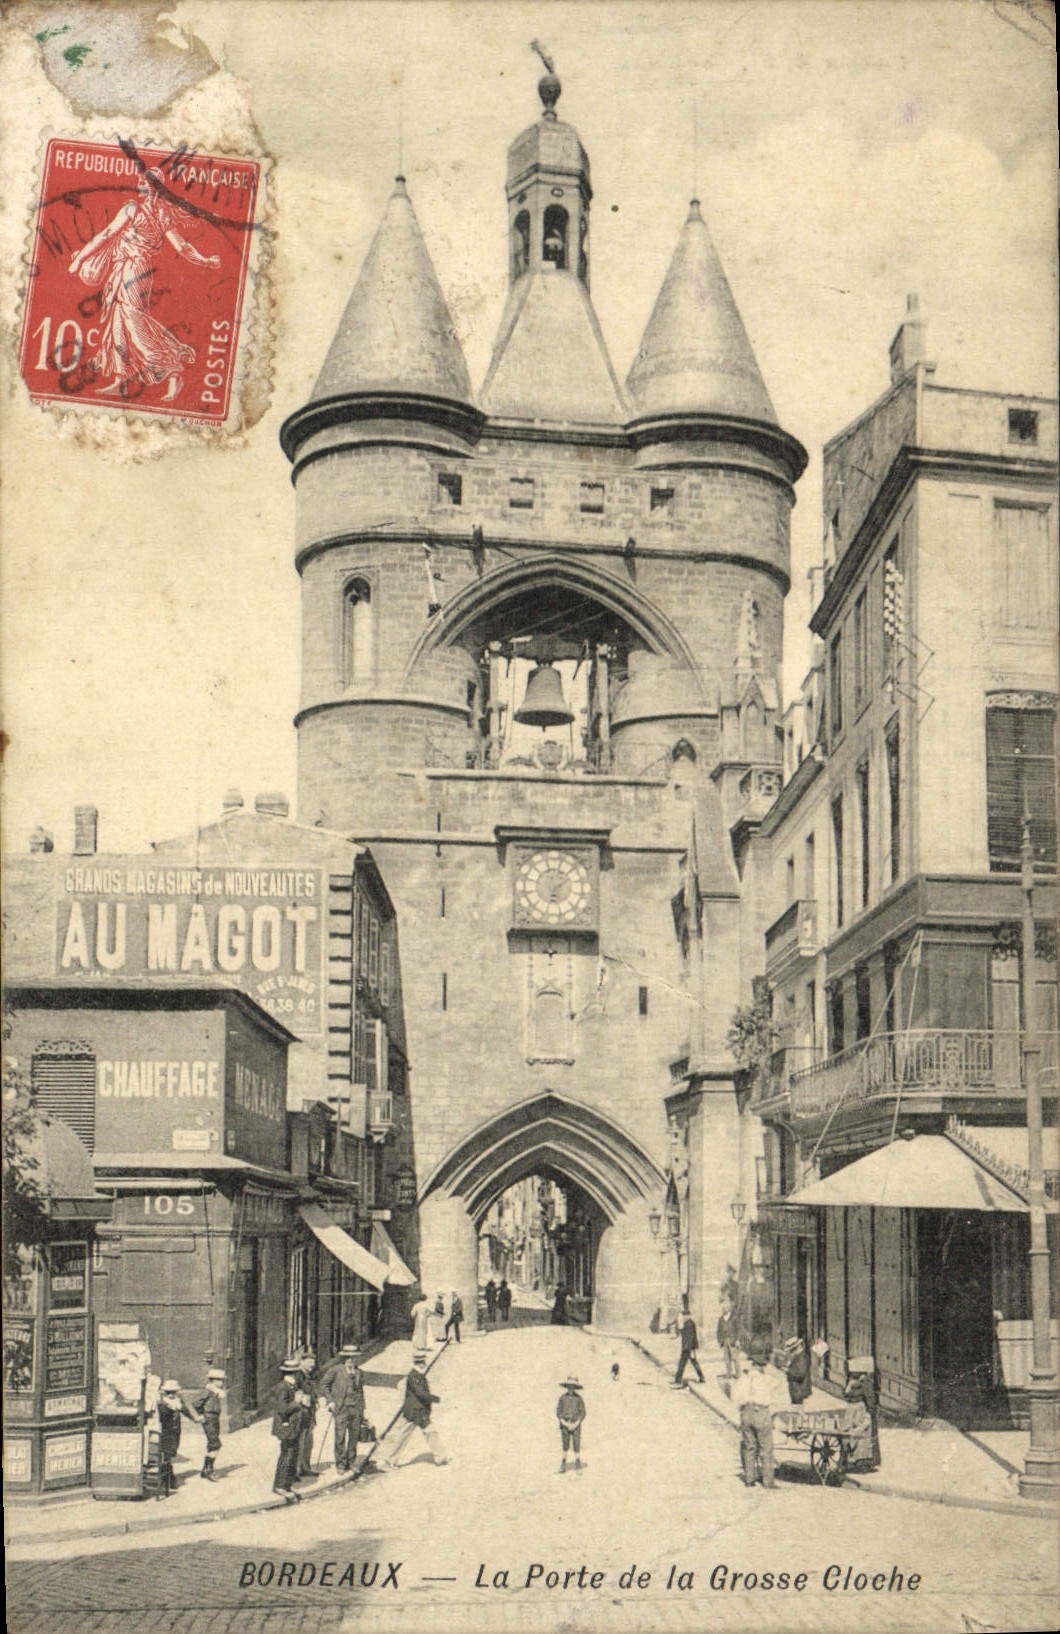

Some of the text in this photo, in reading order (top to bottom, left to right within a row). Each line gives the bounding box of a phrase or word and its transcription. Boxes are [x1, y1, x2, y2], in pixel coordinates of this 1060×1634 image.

[201, 319, 231, 403] POSTES
[66, 868, 316, 897] GRANDS MAGASINS de NOUVEAUTES
[61, 901, 318, 973] AU MAGOT
[99, 1060, 220, 1099] CHAUFFAGE
[142, 1195, 195, 1216] 105
